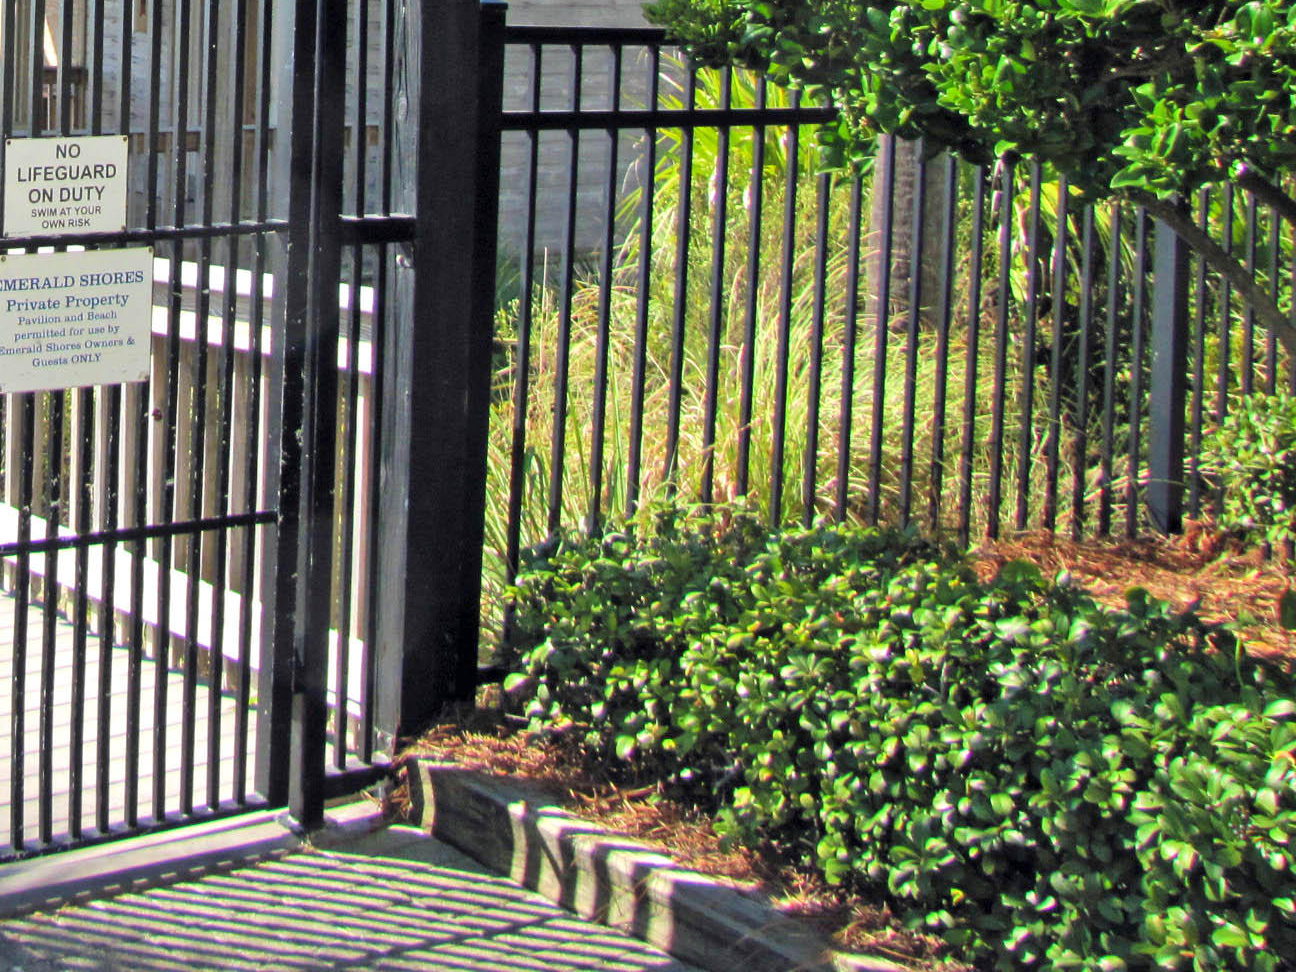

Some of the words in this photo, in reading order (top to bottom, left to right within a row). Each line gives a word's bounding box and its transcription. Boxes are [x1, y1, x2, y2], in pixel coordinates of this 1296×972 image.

[55, 143, 81, 159] NO
[17, 163, 117, 183] LIFEGUARD
[28, 188, 54, 204] ON
[59, 186, 106, 202] DUTY
[31, 207, 58, 218] SWIM
[60, 206, 73, 216] AT
[74, 206, 102, 216] YOUR
[41, 219, 66, 229] OWN
[68, 218, 91, 228] RISK
[79, 270, 145, 287] SHORES
[6, 296, 61, 313] Private
[65, 294, 130, 310] Property
[18, 313, 61, 326] Pavilion
[64, 312, 84, 323] and
[87, 310, 117, 321] Beach
[14, 328, 67, 343] permitted
[69, 327, 85, 337] for
[88, 326, 105, 334] use
[107, 323, 120, 335] by
[45, 339, 82, 353] Shores
[84, 337, 124, 348] Owners
[126, 336, 136, 346] &
[32, 356, 68, 368] Guests
[71, 353, 102, 365] ONLY
